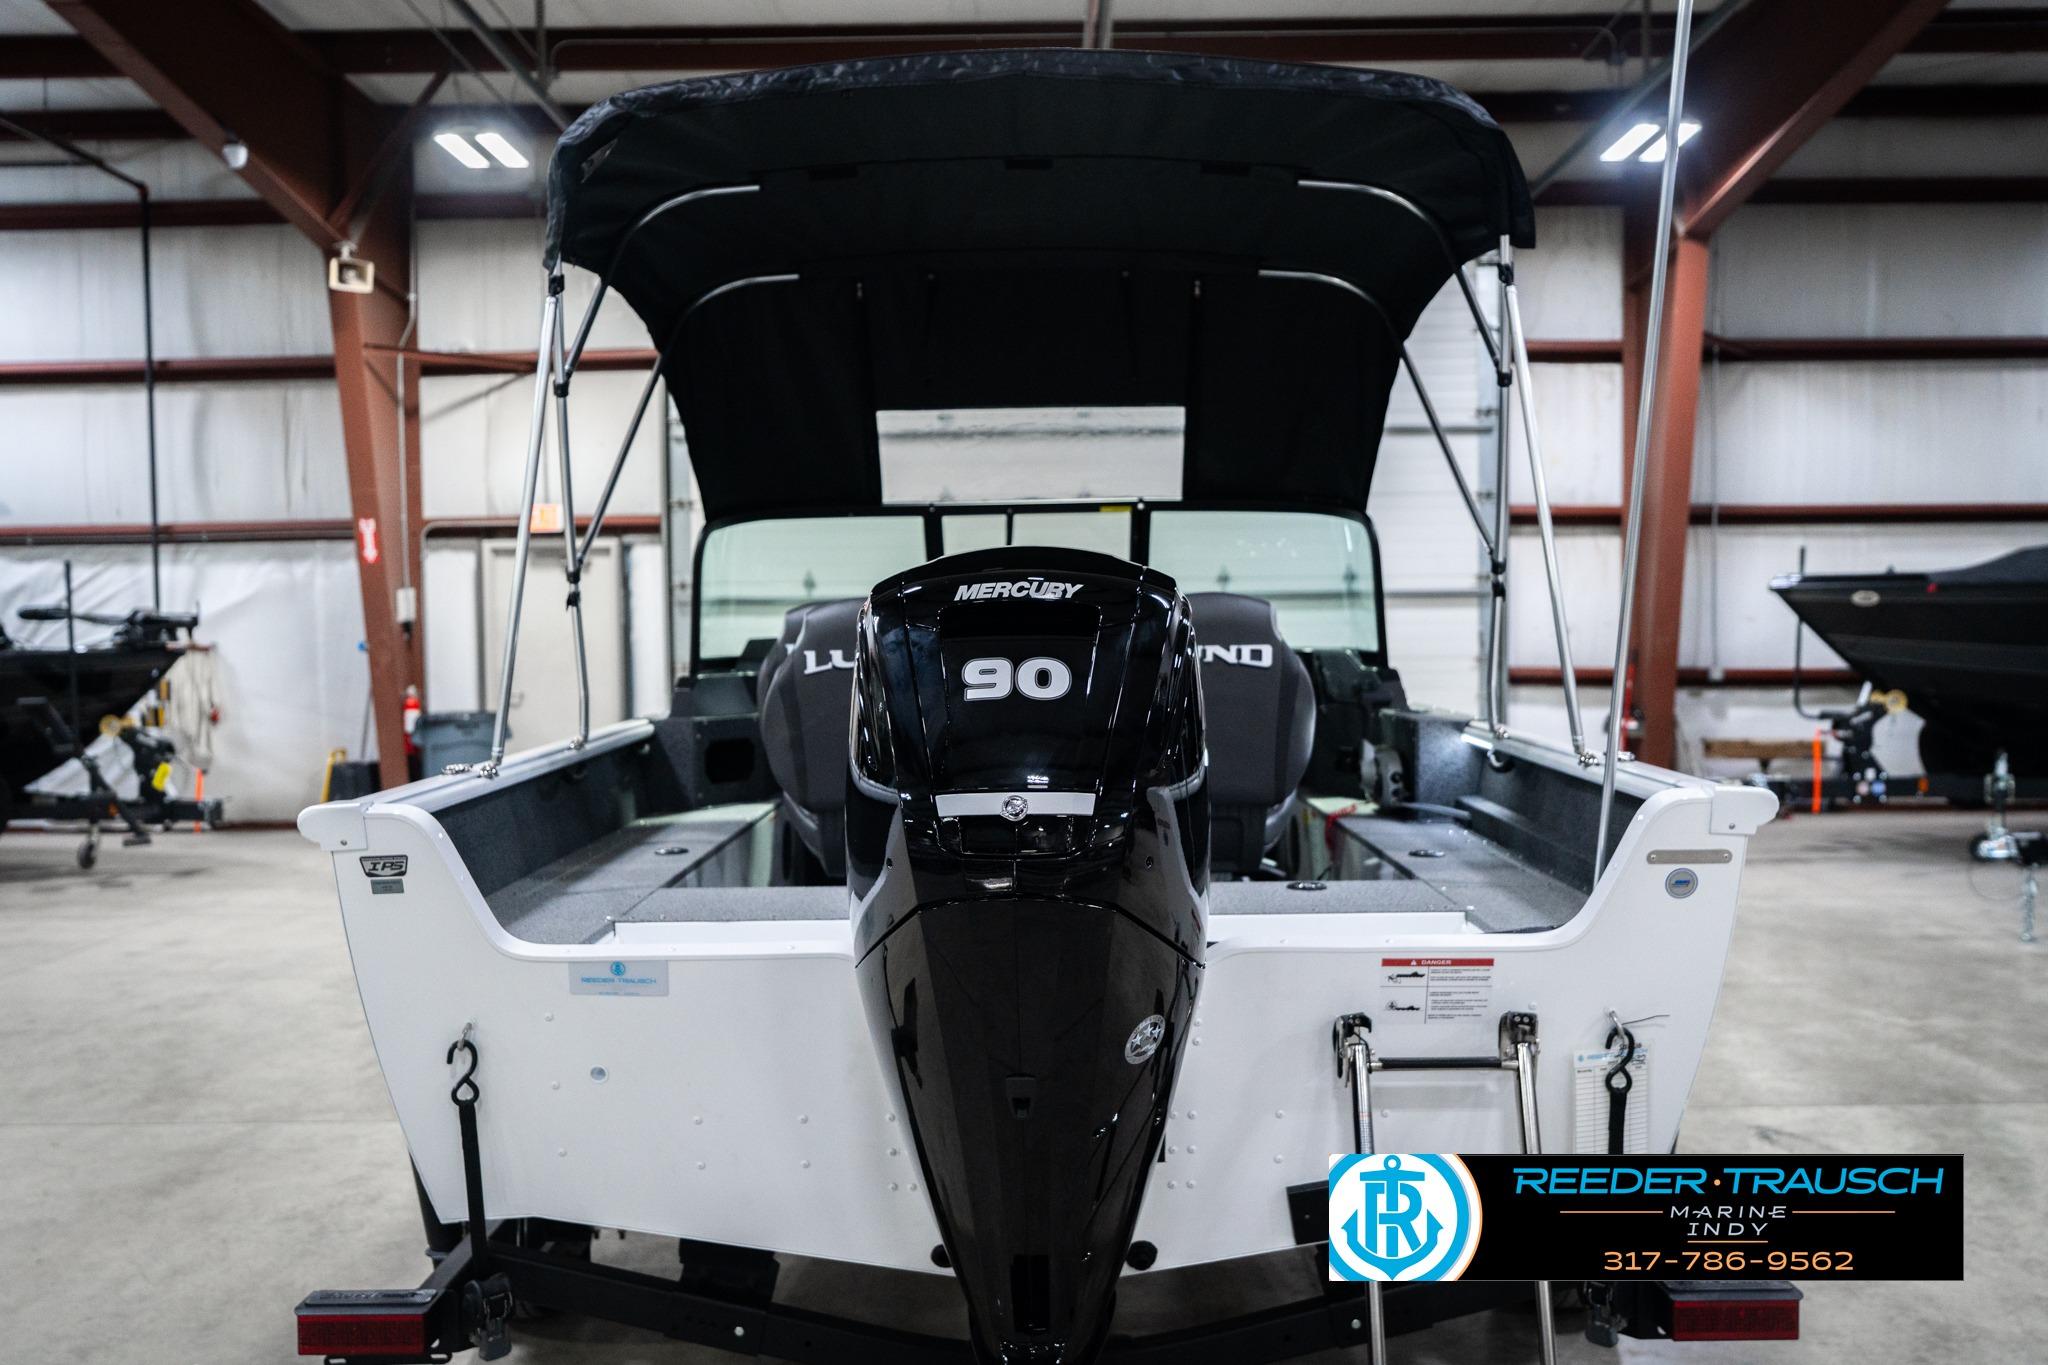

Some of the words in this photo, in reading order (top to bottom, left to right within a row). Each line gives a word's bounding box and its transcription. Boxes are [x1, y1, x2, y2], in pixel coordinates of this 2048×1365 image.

[953, 581, 1084, 601] MERCURY
[803, 649, 857, 675] LU
[961, 656, 1073, 702] 90
[368, 860, 405, 872] IPS
